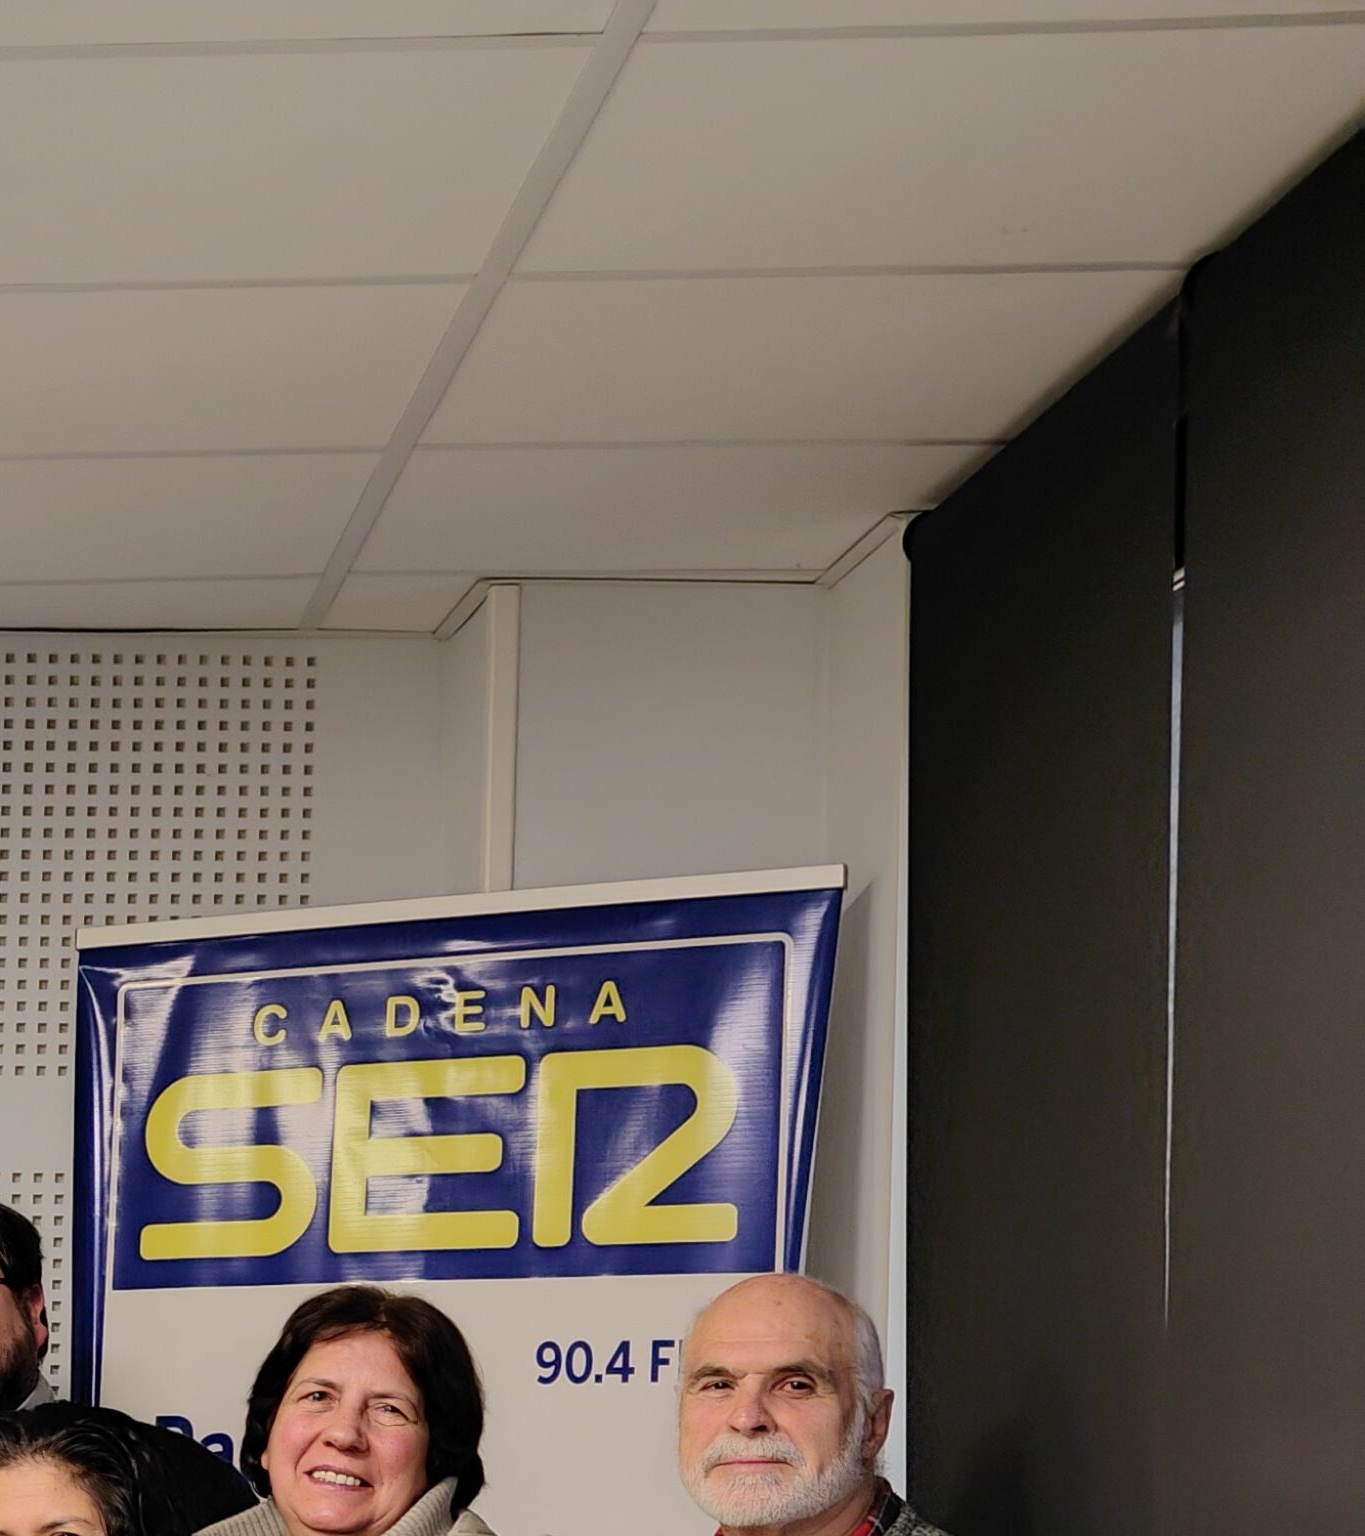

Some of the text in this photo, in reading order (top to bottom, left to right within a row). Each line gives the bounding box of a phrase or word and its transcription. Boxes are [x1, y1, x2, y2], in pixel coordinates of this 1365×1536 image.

[252, 980, 627, 1047] CADENA
[139, 1044, 739, 1261] SER
[535, 1339, 683, 1385] 90.4 F
